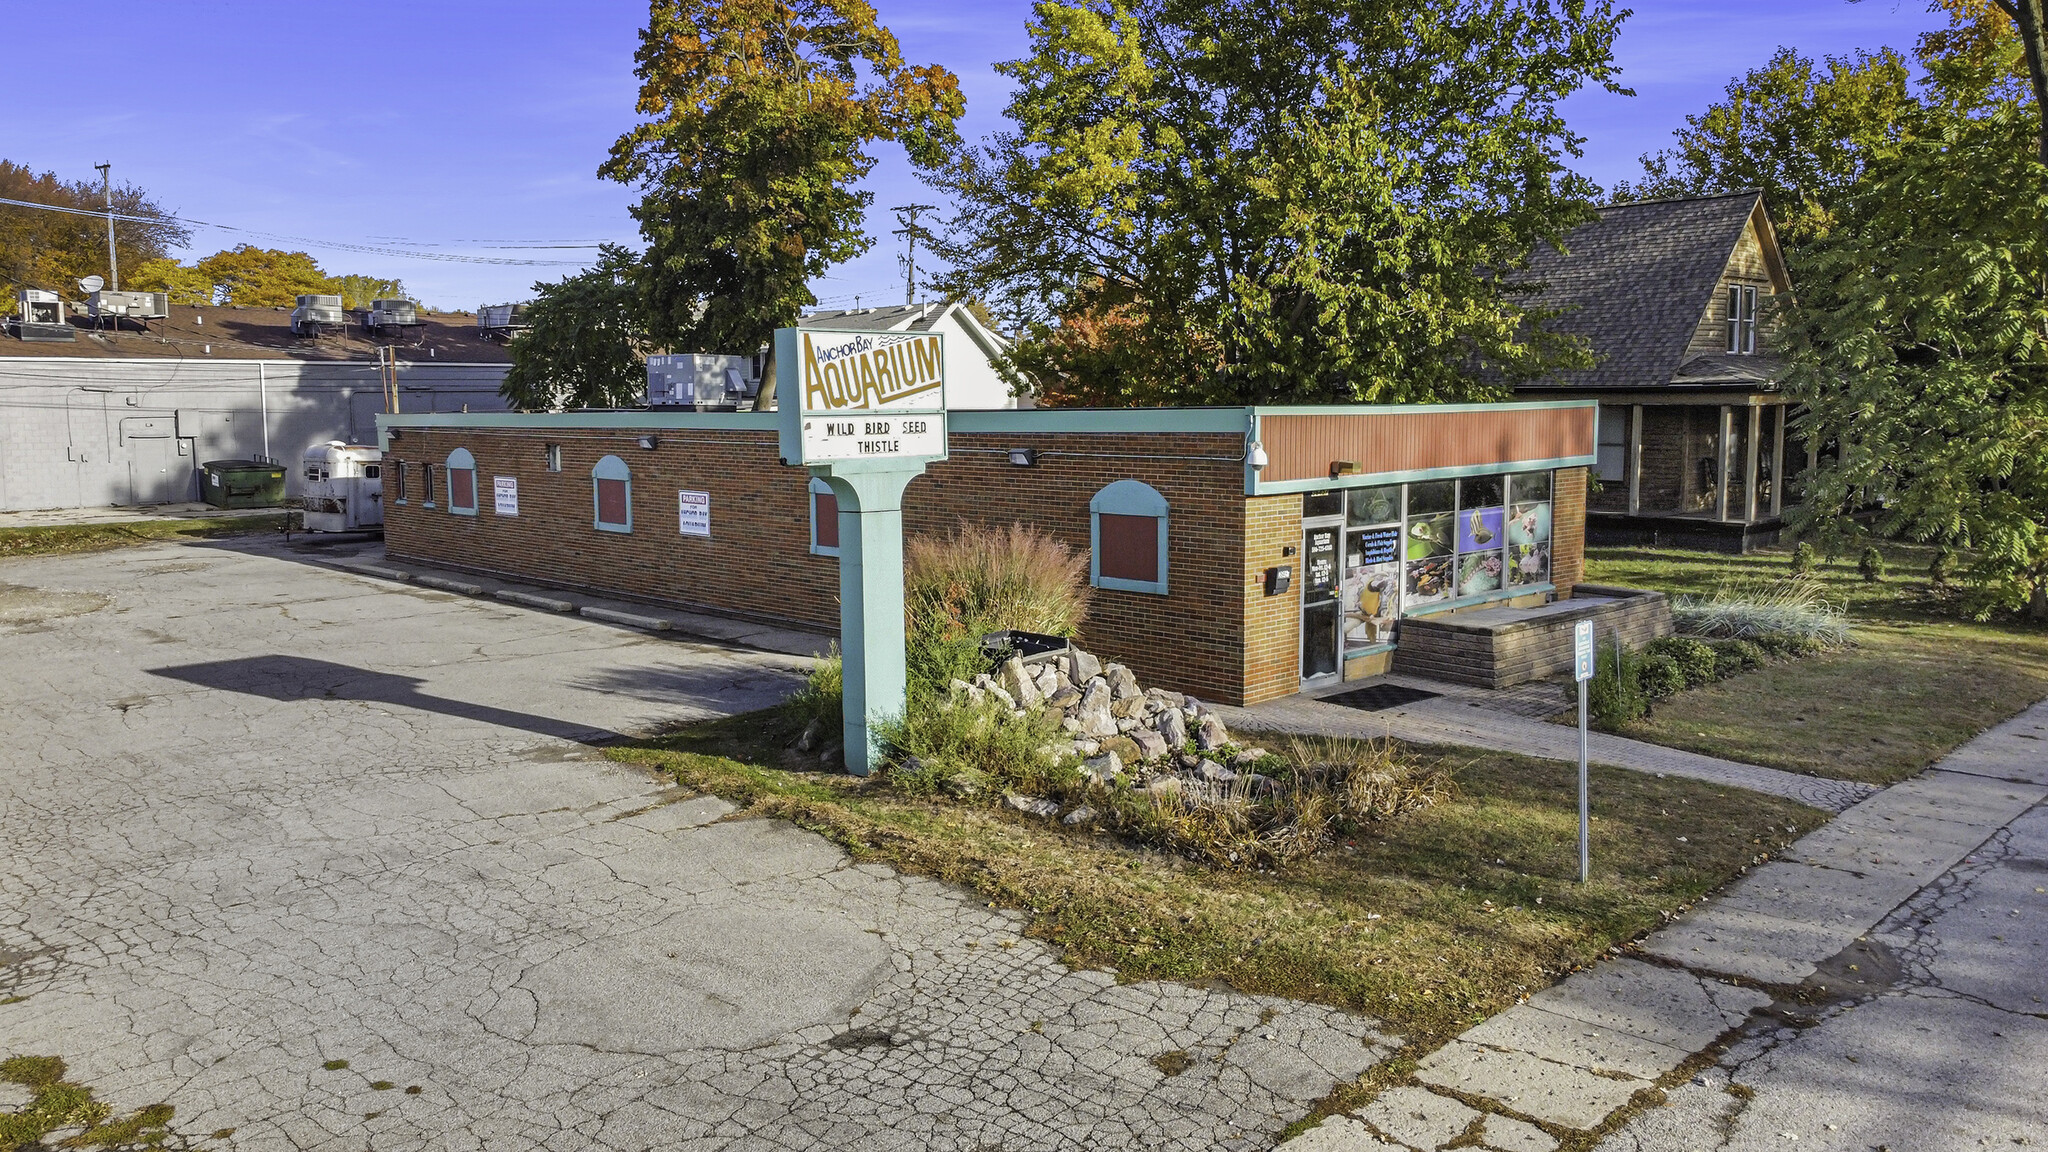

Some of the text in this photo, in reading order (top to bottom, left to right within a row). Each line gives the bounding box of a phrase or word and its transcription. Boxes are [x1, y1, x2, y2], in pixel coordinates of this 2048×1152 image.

[803, 333, 941, 410] AQUARIUM
[826, 421, 927, 436] WILD BIRD SEED
[857, 440, 899, 453] THISTLE
[683, 494, 705, 504] PARKING
